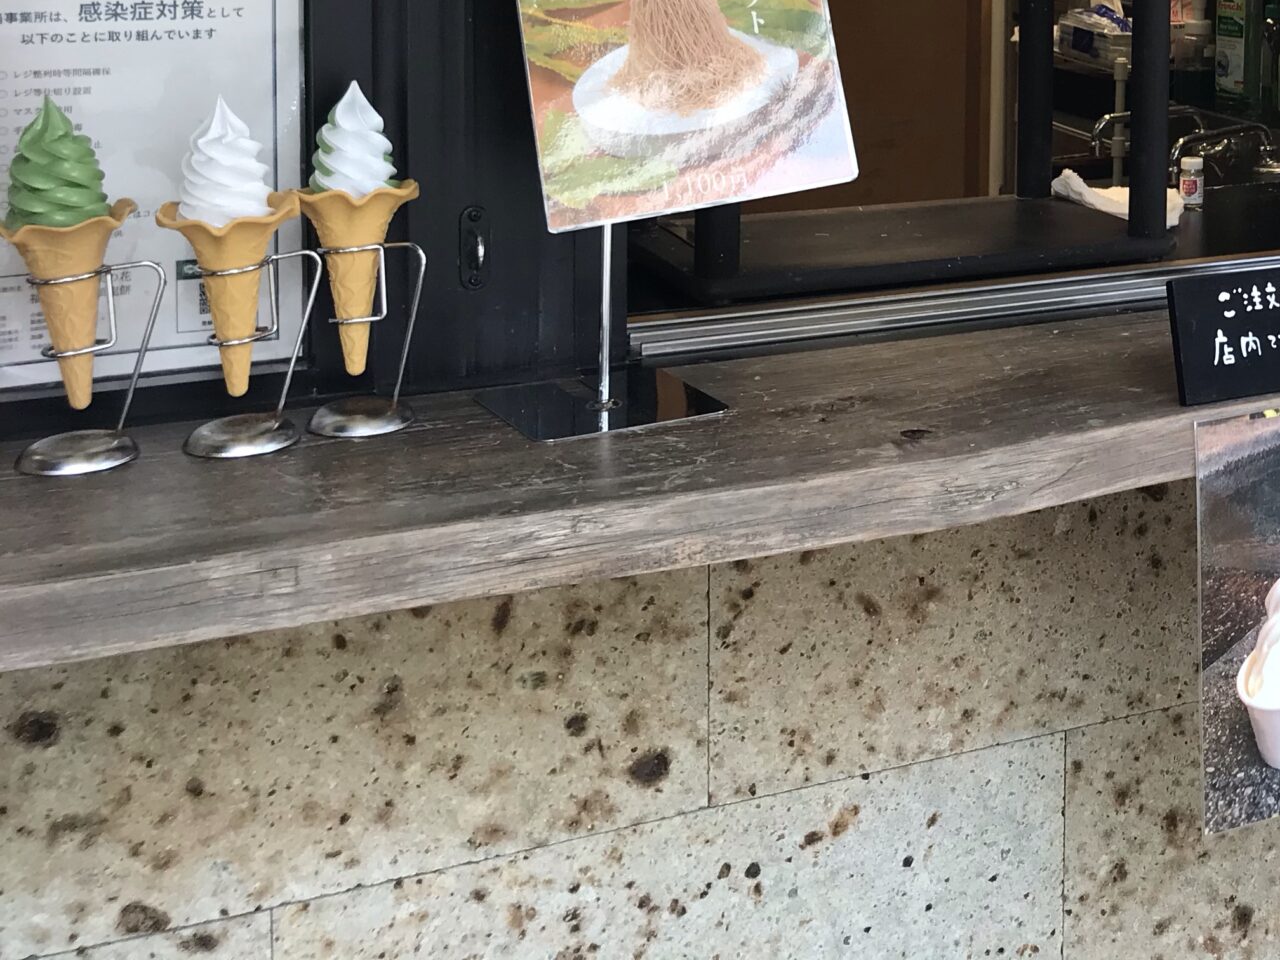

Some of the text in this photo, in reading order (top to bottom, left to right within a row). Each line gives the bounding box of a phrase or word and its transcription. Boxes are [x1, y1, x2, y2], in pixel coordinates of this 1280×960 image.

[20, 27, 218, 46] 以下のことに取り組んでいます
[1217, 281, 1280, 318] ご注文
